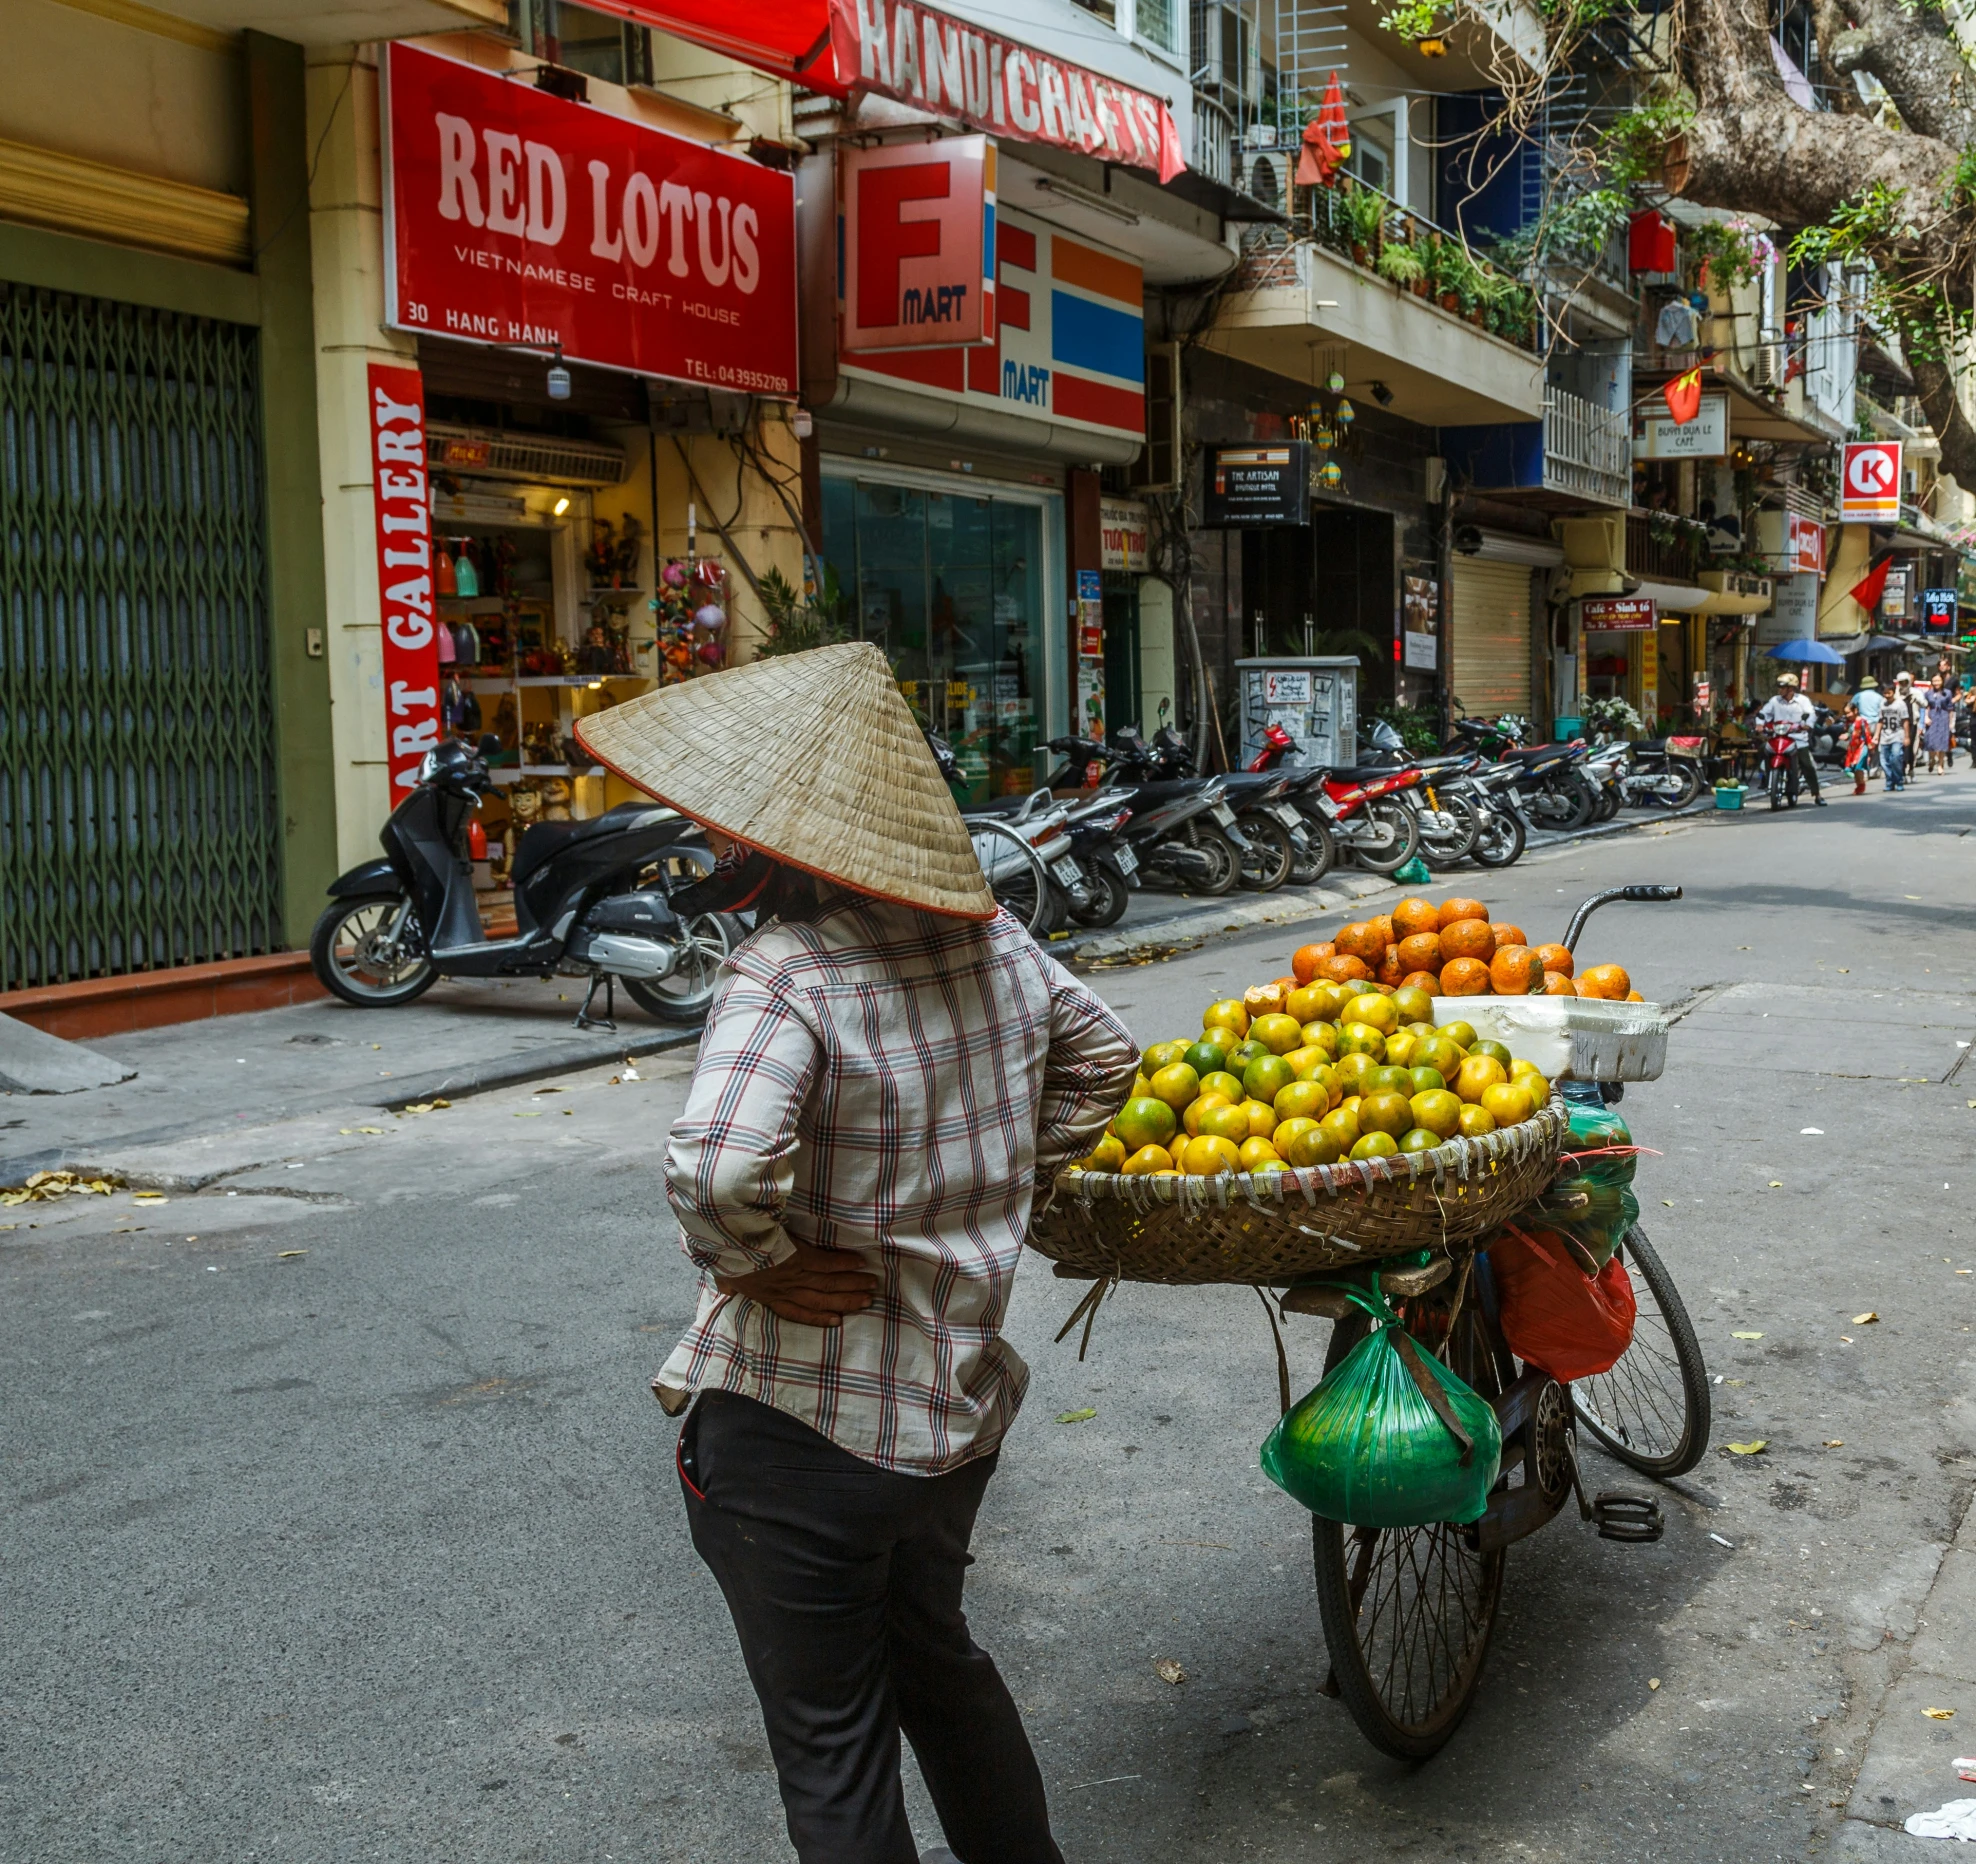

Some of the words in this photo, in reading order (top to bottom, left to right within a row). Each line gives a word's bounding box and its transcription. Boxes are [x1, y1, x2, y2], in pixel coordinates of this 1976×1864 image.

[857, 0, 1161, 158] HANDICRAFTS
[435, 111, 567, 247] RED
[588, 159, 760, 294] LOTUS
[454, 244, 596, 293] VIETNAMESE
[612, 283, 673, 311] CRAFT
[682, 301, 741, 326] HOUSE
[903, 285, 966, 325] MART
[408, 301, 429, 323] 30
[446, 308, 500, 337] HANG
[508, 321, 559, 344] HANH
[1003, 359, 1049, 407] MART
[1232, 471, 1245, 481] THE
[1246, 470, 1280, 481] ARTISAN
[375, 387, 433, 651] GALLERY
[1615, 602, 1636, 613] Sinh
[1931, 603, 1947, 615] 12
